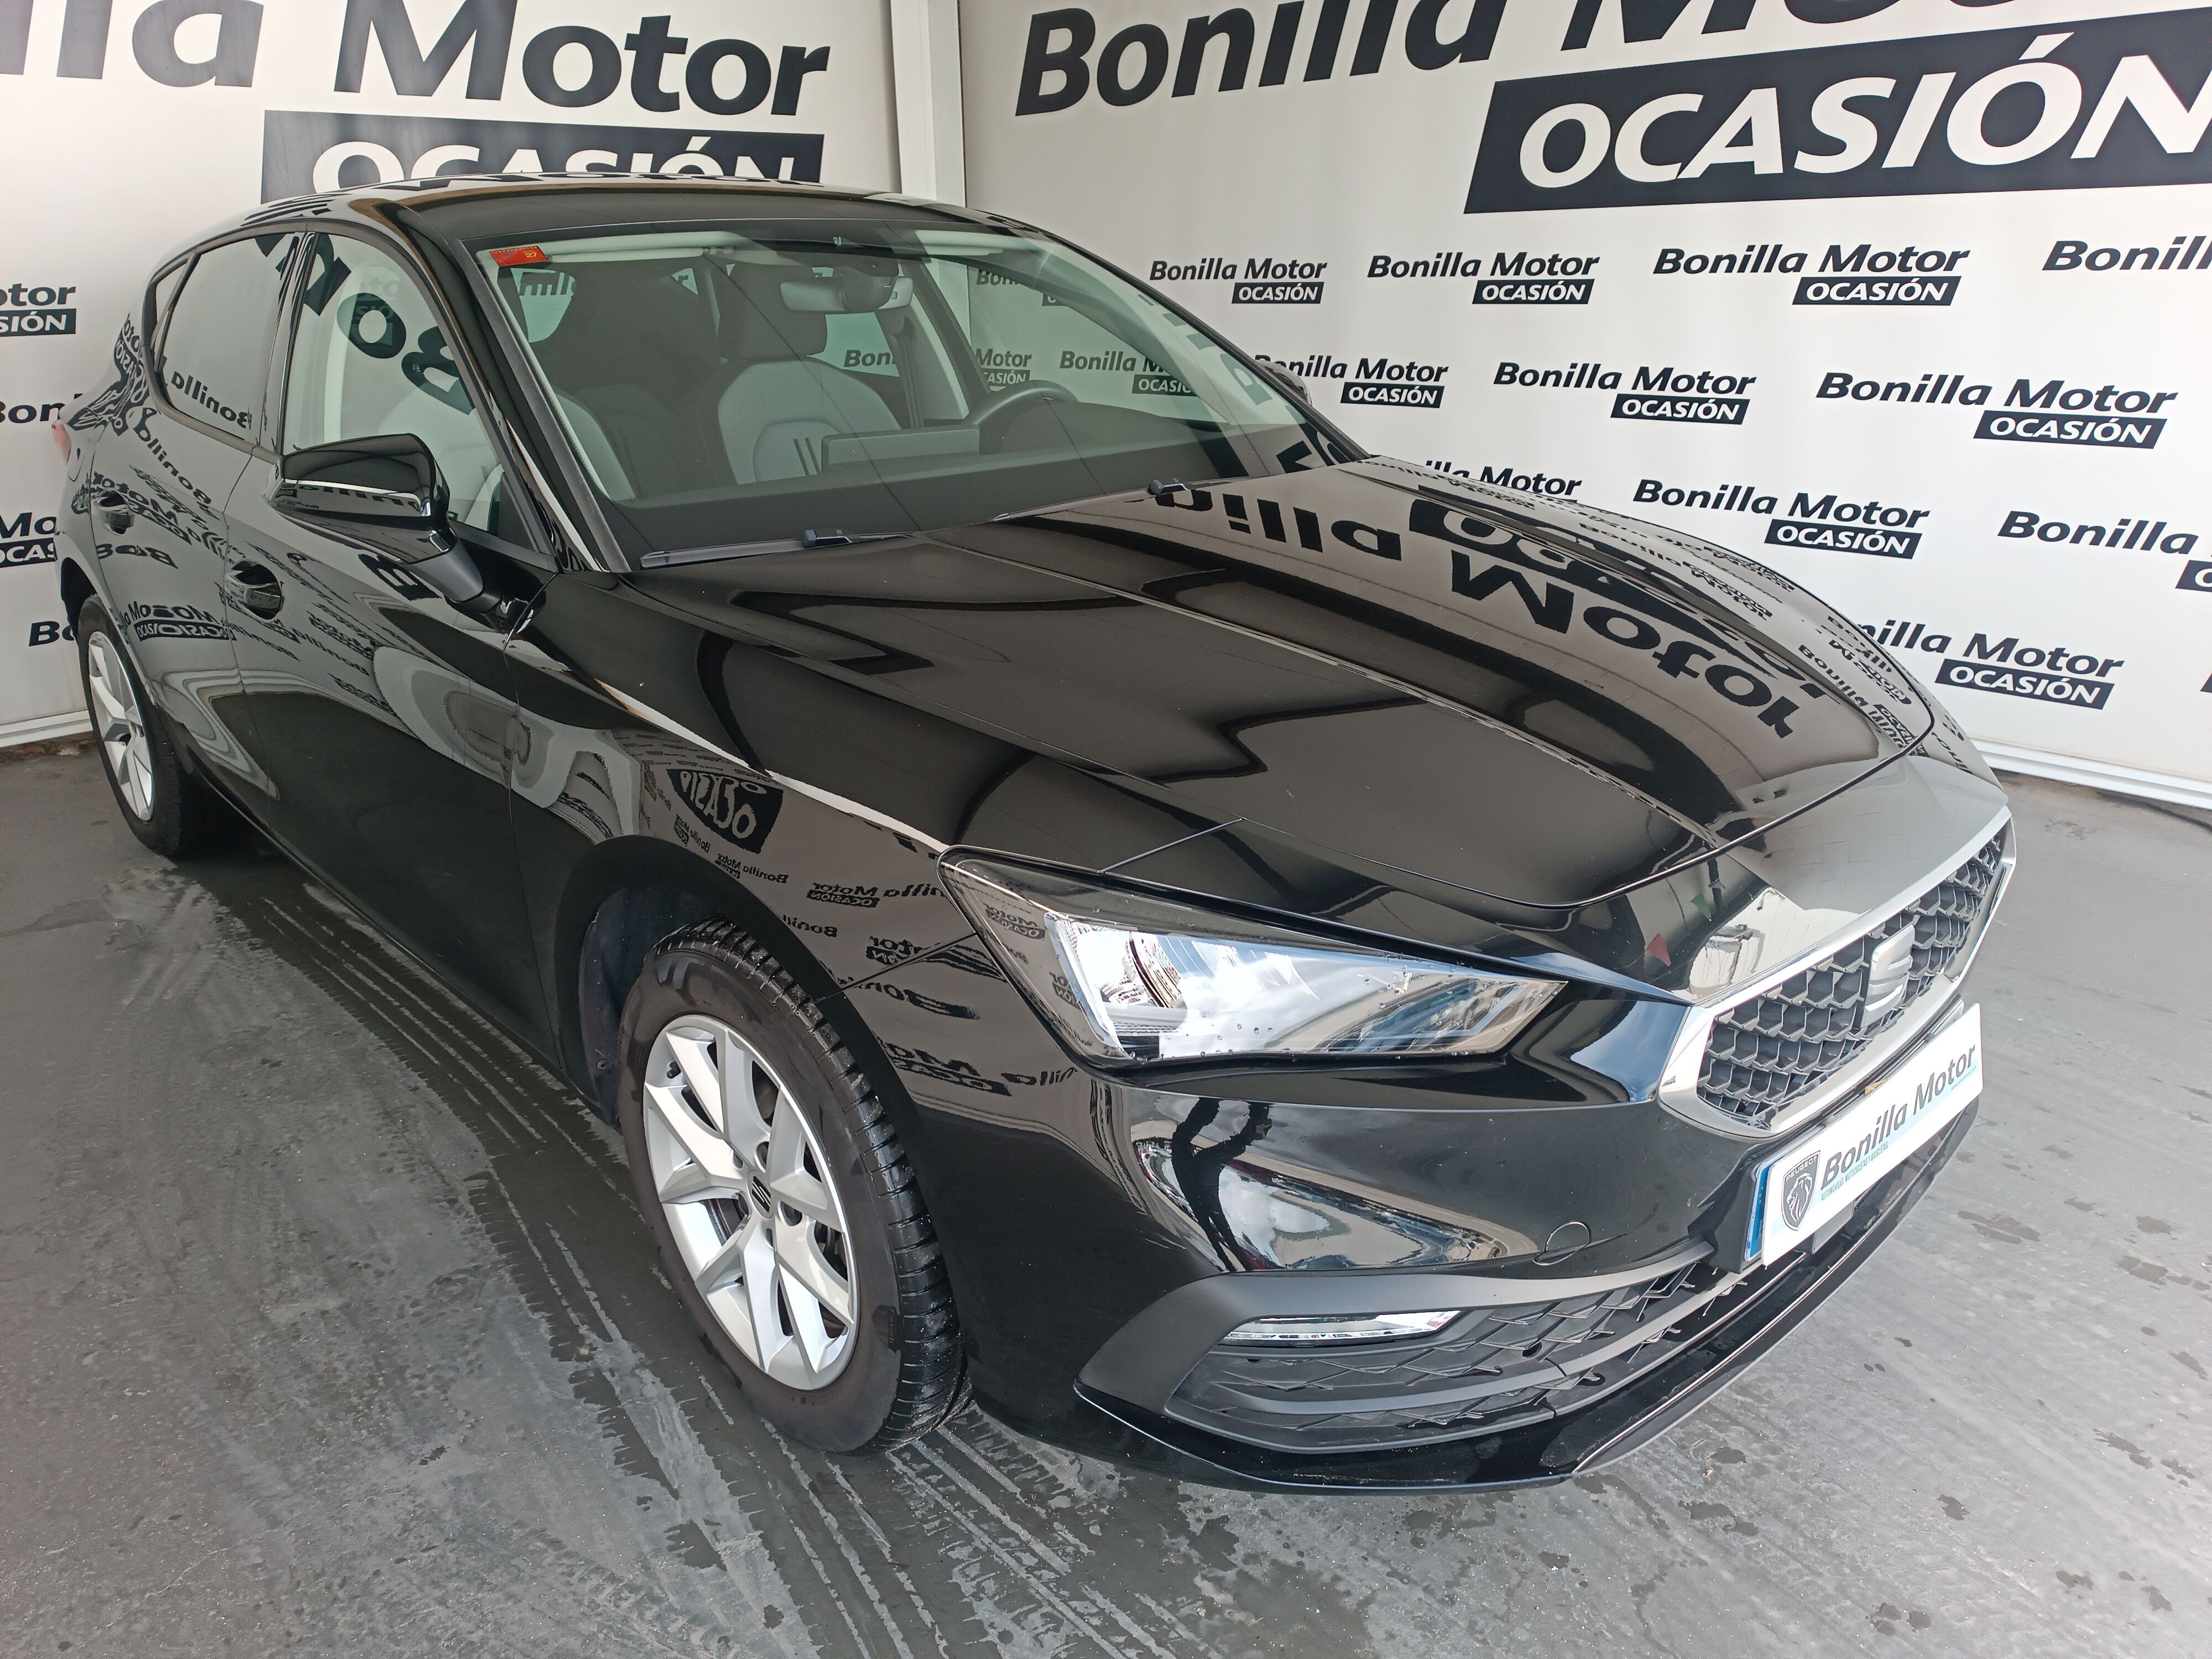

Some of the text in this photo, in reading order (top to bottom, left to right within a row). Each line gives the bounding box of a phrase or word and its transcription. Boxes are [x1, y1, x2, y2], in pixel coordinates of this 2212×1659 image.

[334, 0, 831, 116] Motor
[1520, 32, 2212, 187] OCASIÓN
[1367, 252, 1600, 278] Bonilla Motor
[1653, 244, 1970, 274] Bonilla Motor
[2042, 236, 2212, 270] Bonill
[1150, 258, 1327, 280] Bonilla Motor
[0, 283, 76, 306] tor
[1239, 283, 1318, 300] OCASIÓN
[1483, 281, 1585, 300] OCASIÓN
[1807, 278, 1948, 301] OCASIÓN
[976, 349, 1032, 367] Motor
[1060, 351, 1136, 371] Bonilla
[1255, 354, 1448, 382] nilla Motor
[983, 371, 1026, 384] ASIÓN
[1139, 379, 1191, 393] OCASI
[1494, 362, 1756, 394] Bonilla Motor
[1348, 387, 1437, 404] OCASIÓN
[1815, 373, 2178, 413] Bonilla Motor
[1622, 399, 1739, 420] OCASIÓN
[1990, 418, 2151, 443] OCASIÓN
[1480, 466, 1582, 495] Motor
[1633, 479, 1931, 528] Bonilla Motor
[1777, 526, 1910, 554] OCASIÓN
[1997, 511, 2198, 554] Bonilla
[1963, 633, 2125, 677] Motor
[1949, 667, 2100, 703] OCASIÓN
[1821, 1044, 1975, 1190] Bonilla Motor
[1786, 1155, 1818, 1182] PEUGEOT
